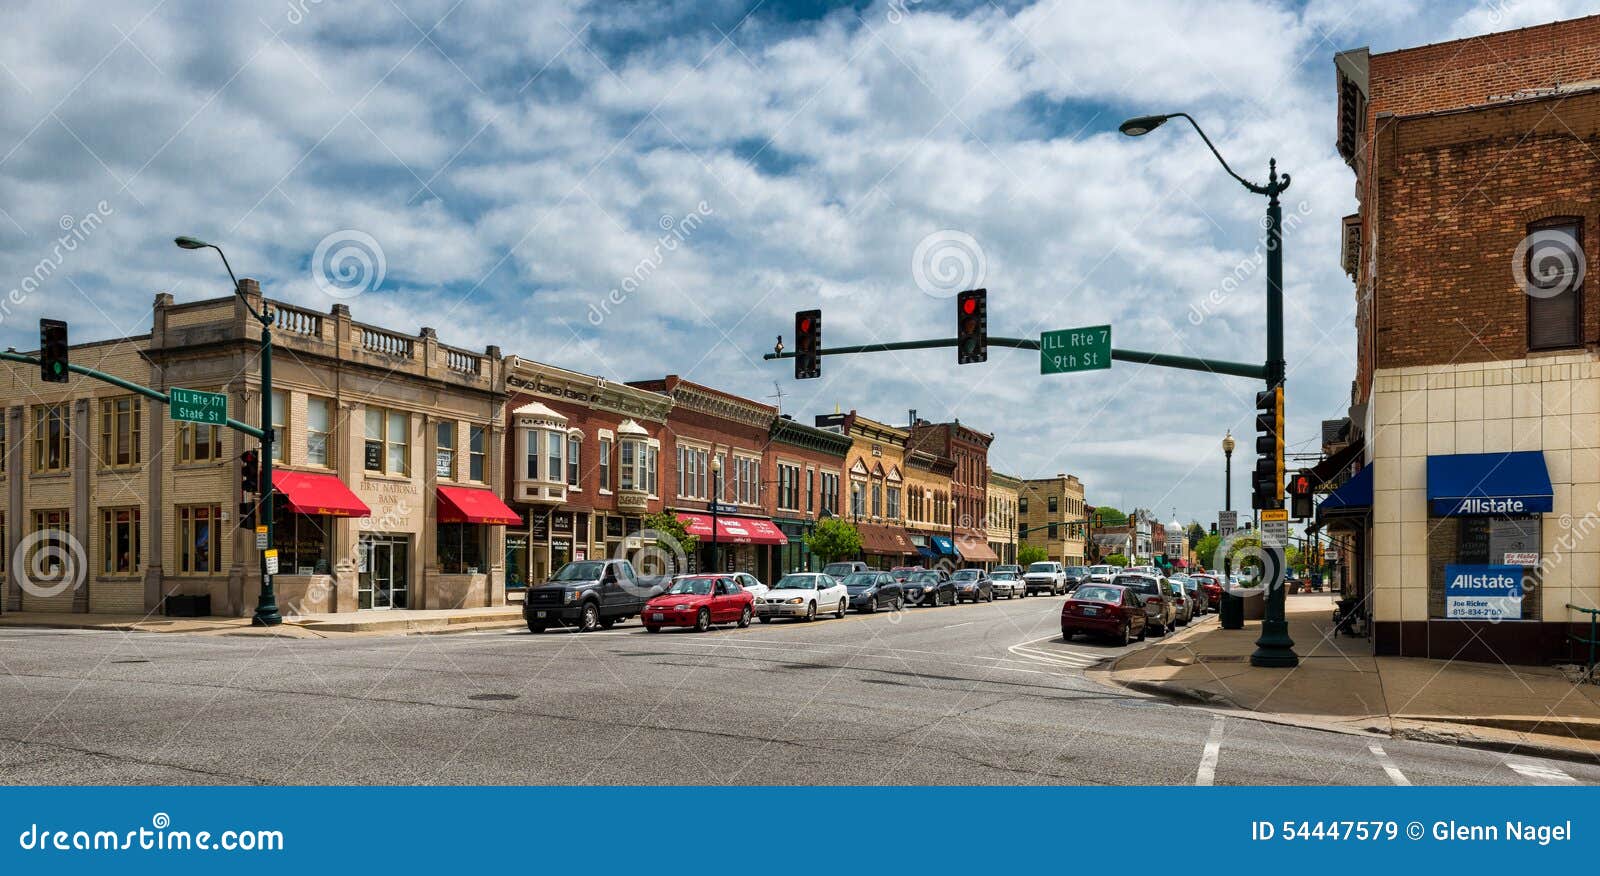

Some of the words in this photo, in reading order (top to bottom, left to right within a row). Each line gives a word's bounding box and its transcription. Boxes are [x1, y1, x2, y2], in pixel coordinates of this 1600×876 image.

[1043, 336, 1065, 349] ILL
[1071, 333, 1094, 346] Rte
[1099, 330, 1108, 344] 7
[1054, 355, 1077, 368] 9th
[1083, 352, 1098, 366] St
[192, 394, 208, 405] Rte
[211, 395, 224, 406] 171
[179, 407, 204, 420] State
[209, 410, 219, 421] St
[360, 481, 379, 492] FIRST
[384, 482, 417, 495] NATIONAL
[378, 494, 399, 504] BANK
[1457, 498, 1524, 513] Allstate
[1450, 574, 1515, 589] Allstate
